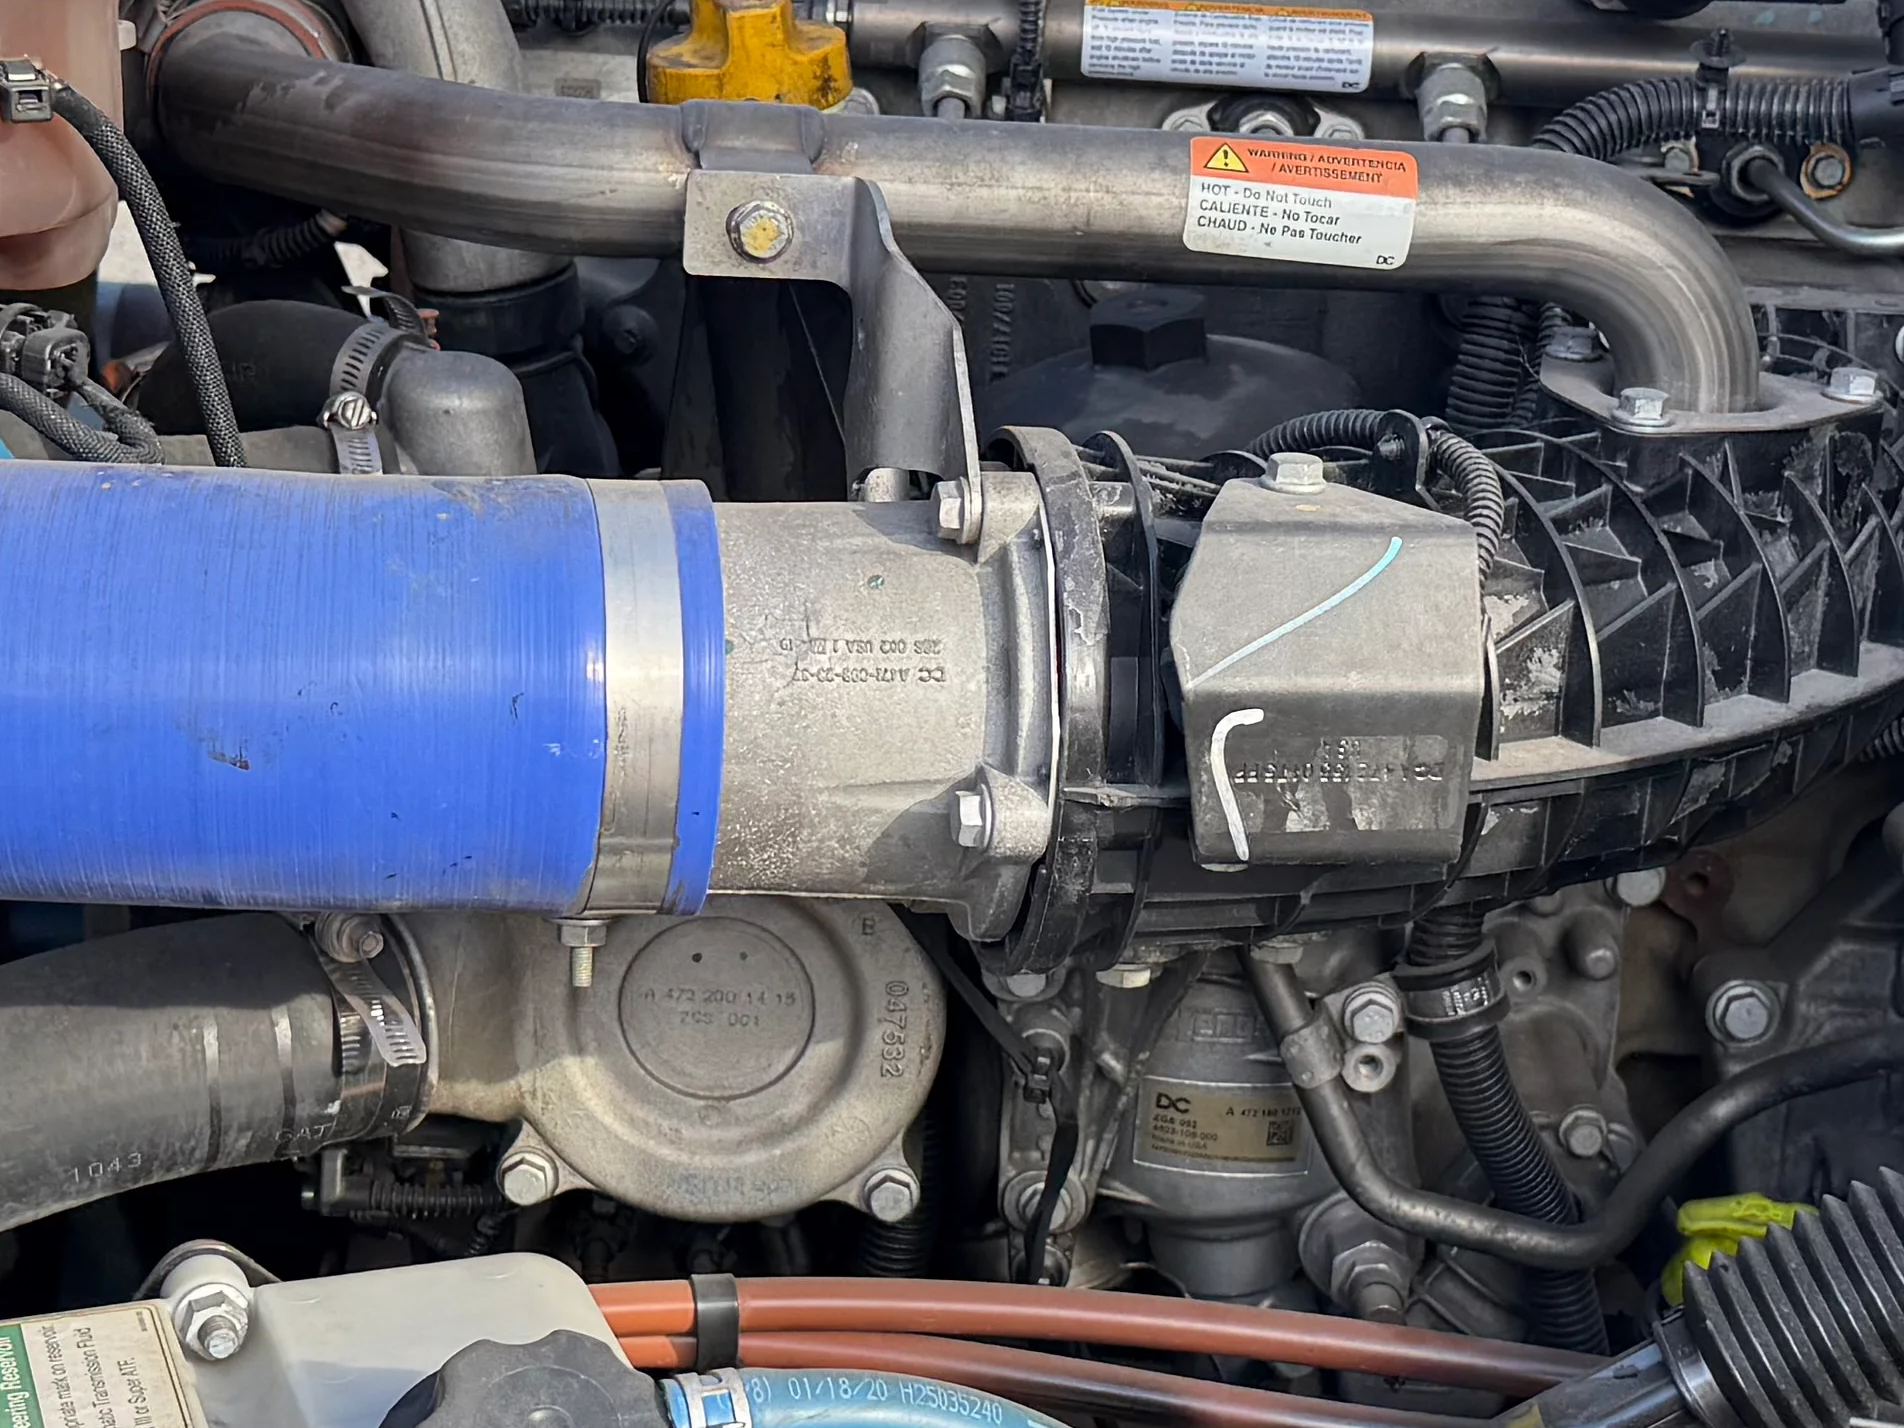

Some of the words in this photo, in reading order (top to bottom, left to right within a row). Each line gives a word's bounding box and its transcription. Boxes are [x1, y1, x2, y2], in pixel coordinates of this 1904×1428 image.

[1248, 146, 1307, 163] WARNING
[1317, 153, 1407, 173] ADVERTENCIA
[1278, 162, 1384, 184] AVERTISSEMENT
[1201, 181, 1228, 197] HOT
[1243, 186, 1262, 201] Do
[1293, 191, 1333, 210] Touch
[1198, 199, 1269, 218] CALIENTE
[1281, 208, 1300, 222] No
[1304, 209, 1340, 226] Tocar
[1196, 215, 1247, 232] CHAUD
[1280, 223, 1305, 239] Pas
[1307, 226, 1363, 246] Toucher
[1376, 254, 1395, 266] DC
[1155, 1092, 1191, 1114] DC
[74, 1327, 96, 1349] Fluid
[84, 1350, 112, 1407] Transmission
[126, 1378, 149, 1404] Super
[787, 1377, 889, 1404] 01/18/20
[898, 1381, 1004, 1427] H25035240
